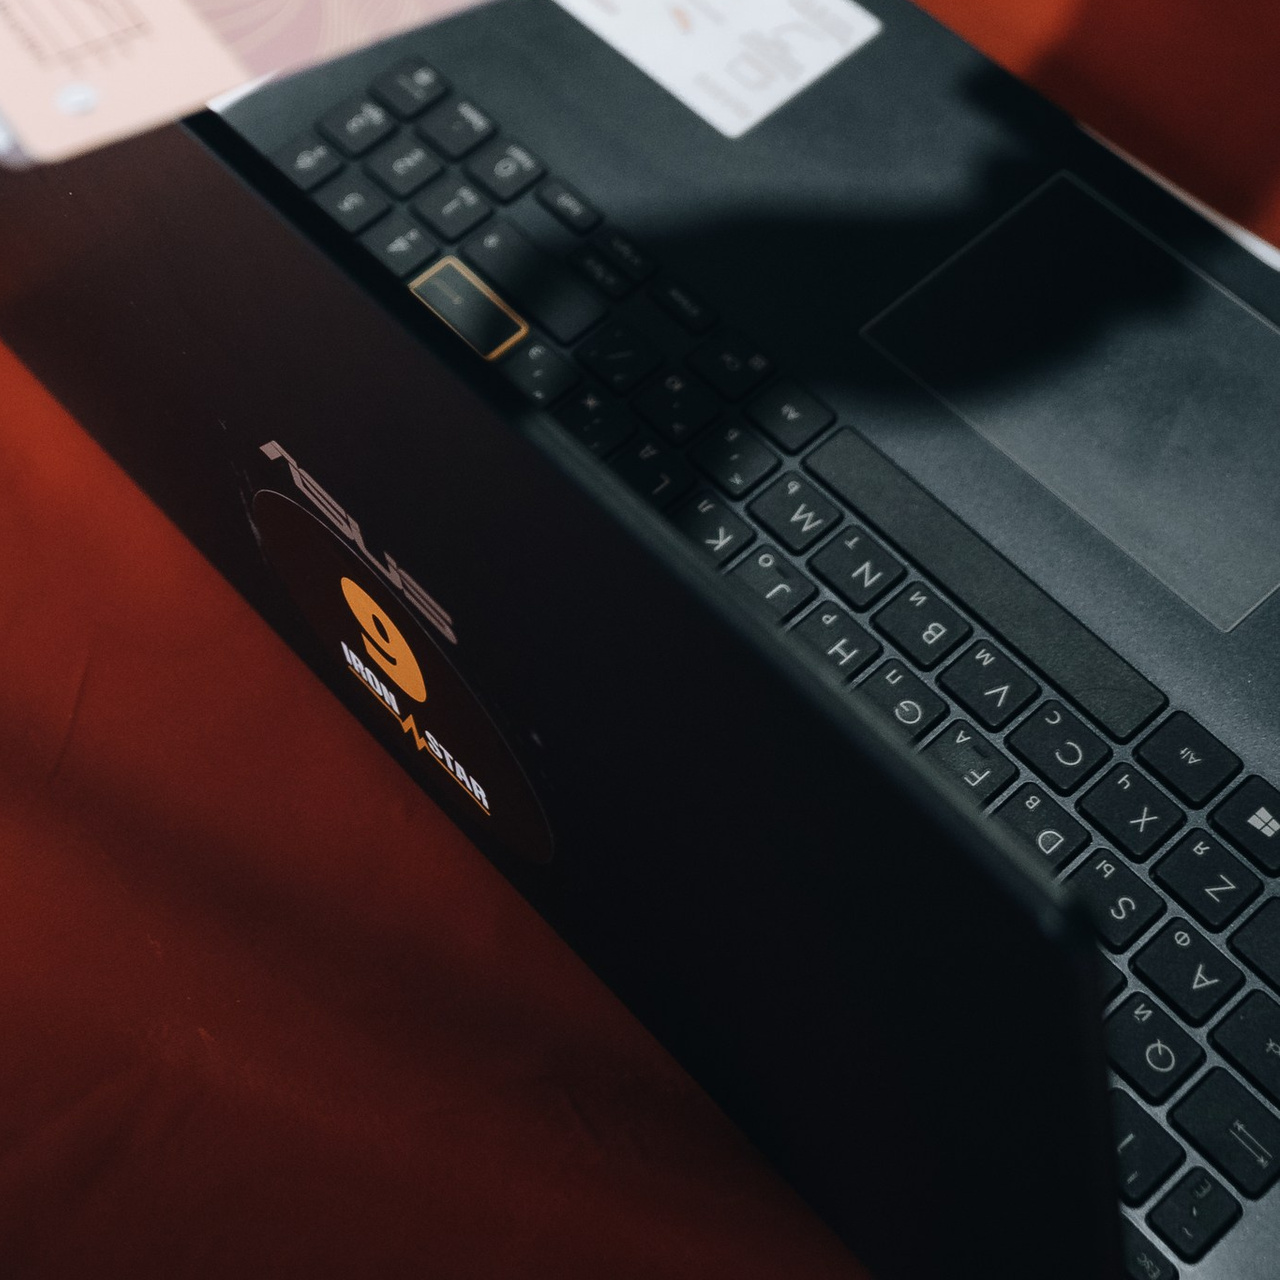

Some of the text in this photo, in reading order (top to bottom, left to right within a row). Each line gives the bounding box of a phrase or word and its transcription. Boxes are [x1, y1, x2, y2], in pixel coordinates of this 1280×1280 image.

[652, 474, 670, 495] L
[790, 503, 823, 532] M
[259, 440, 458, 645] ASUS
[705, 527, 734, 551] K
[851, 561, 883, 588] N
[764, 582, 792, 602] J
[922, 622, 947, 645] B
[827, 638, 858, 666] H
[984, 685, 1010, 708] V
[894, 700, 922, 725] G
[341, 641, 490, 810] IRON STAR
[1055, 741, 1083, 766] C
[963, 763, 991, 788] F
[1129, 806, 1158, 833] X
[1037, 830, 1065, 855] D
[1204, 874, 1236, 903] Z
[1110, 897, 1136, 920] S
[1192, 963, 1220, 990] A
[1145, 1038, 1176, 1072] Q
